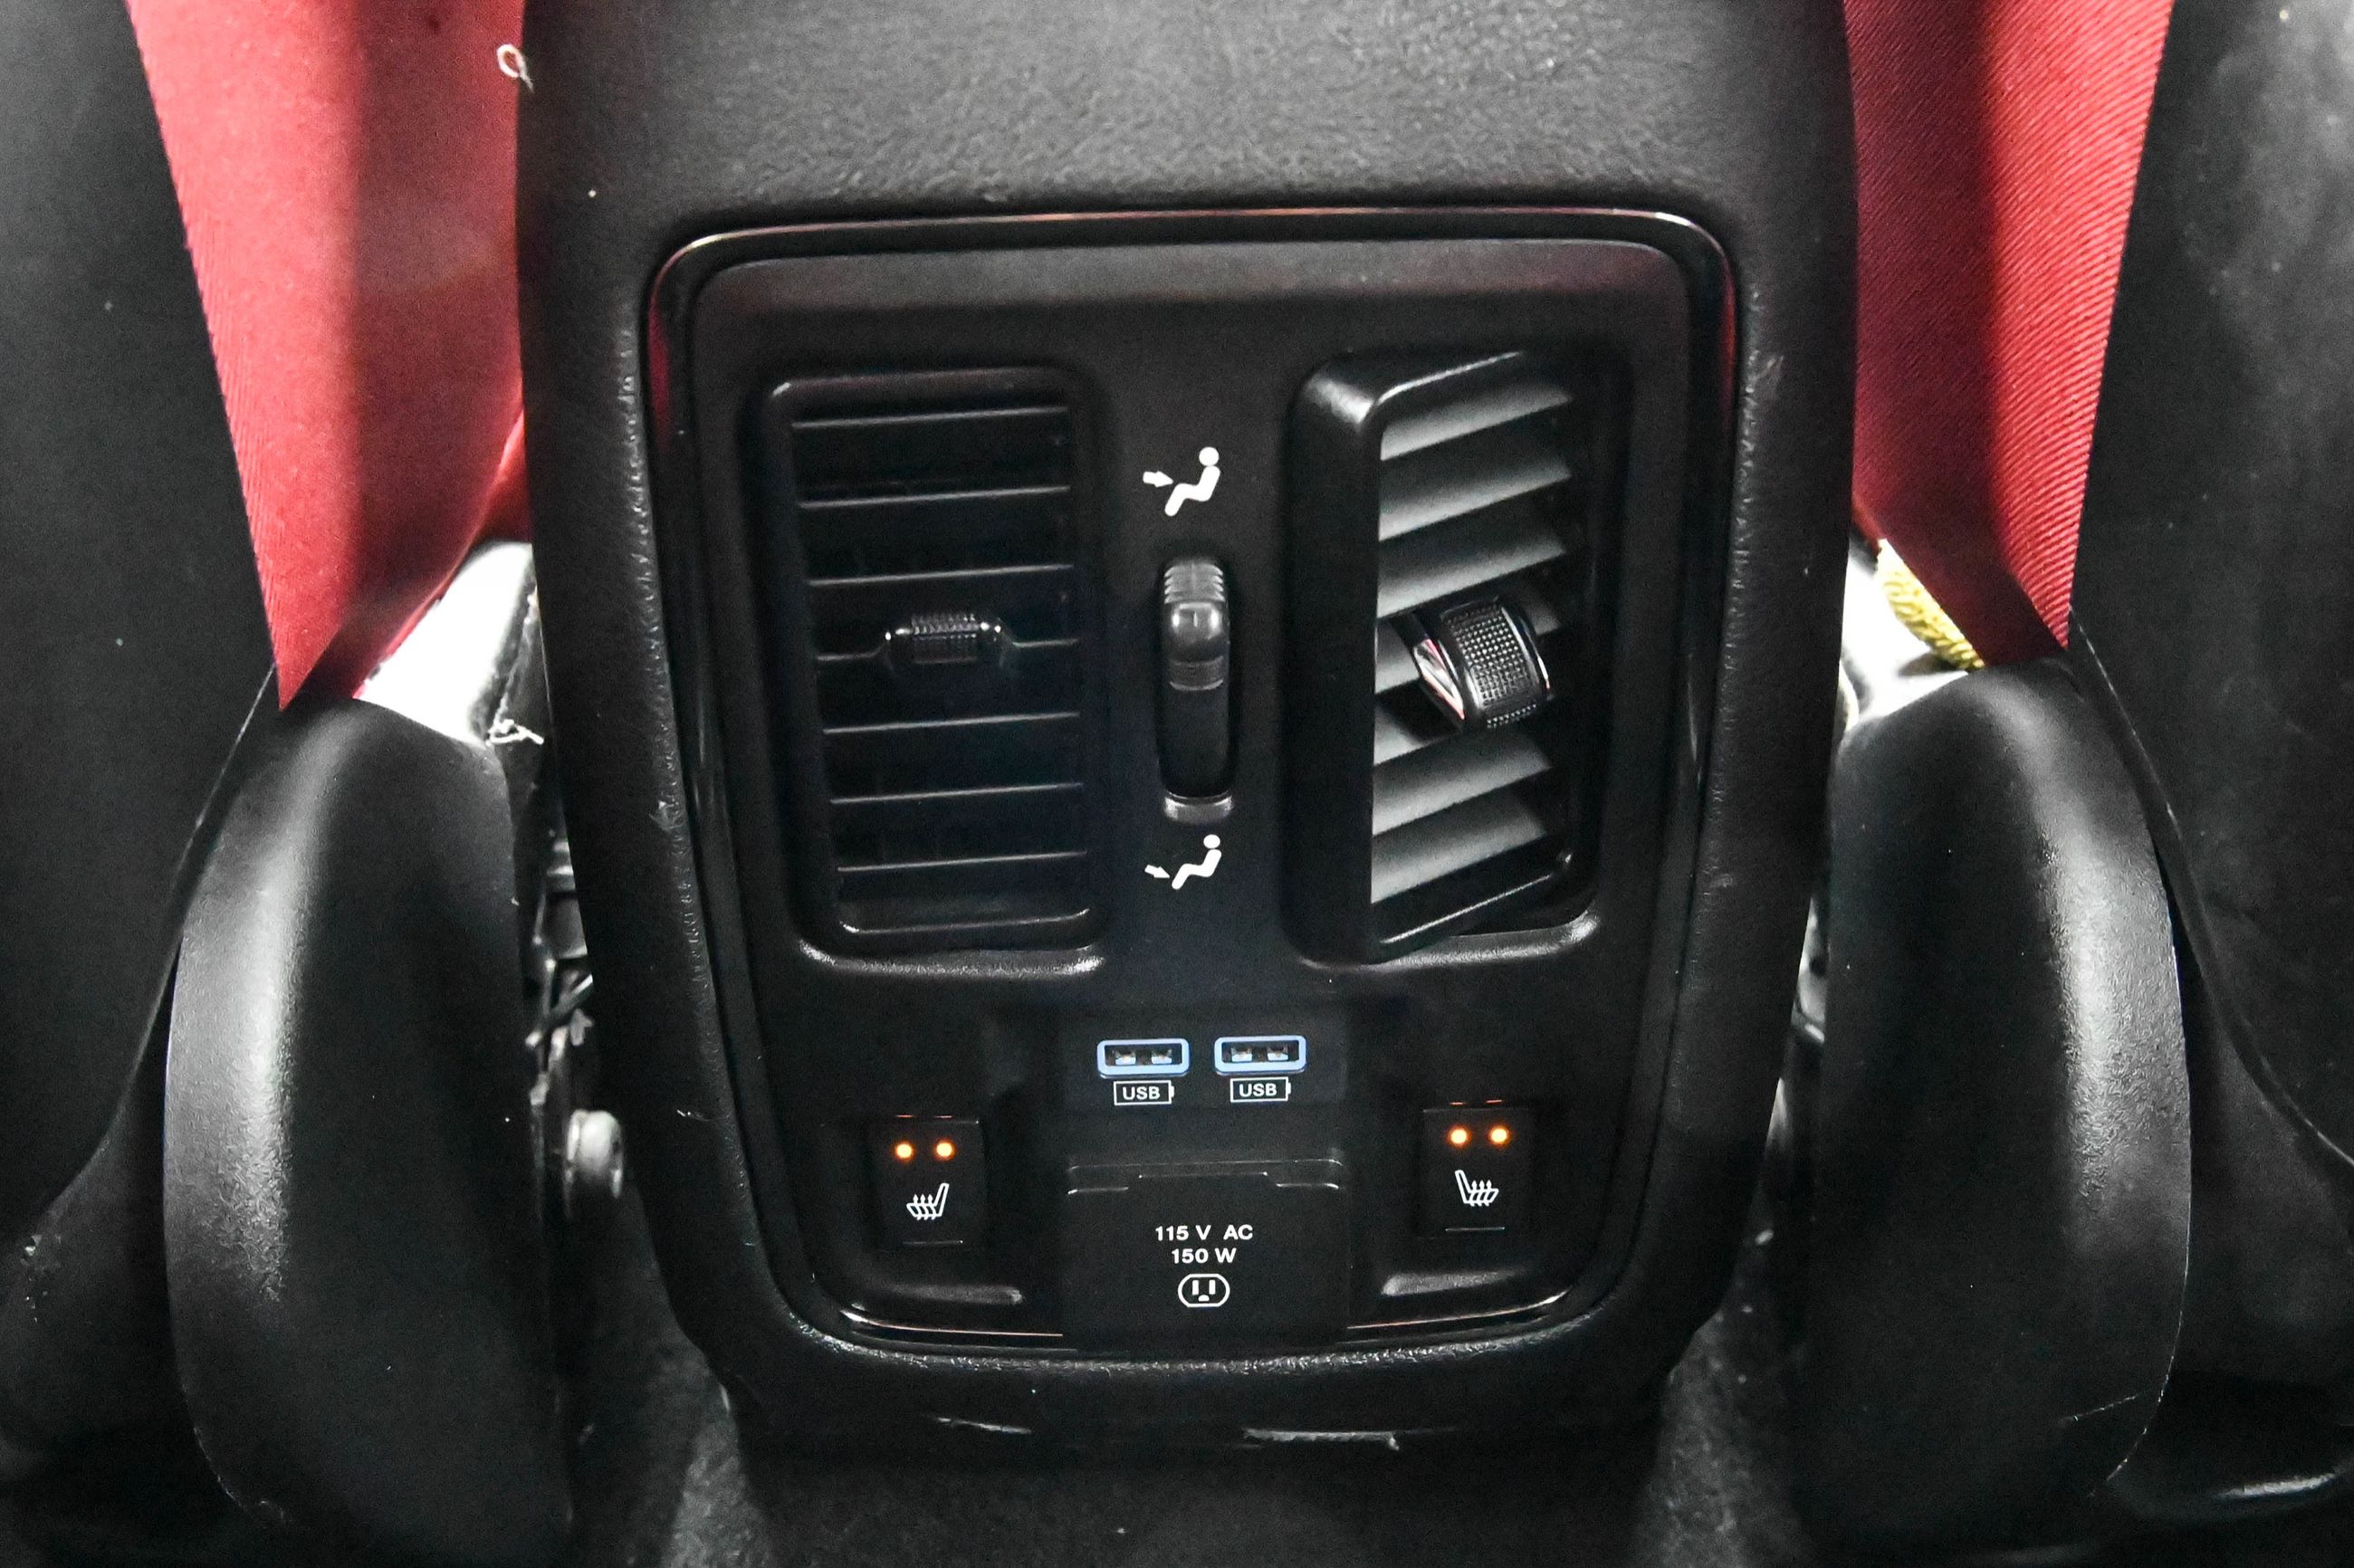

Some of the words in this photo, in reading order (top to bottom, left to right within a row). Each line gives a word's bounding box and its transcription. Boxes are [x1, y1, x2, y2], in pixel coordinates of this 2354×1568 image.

[1121, 1085, 1161, 1100] USB
[1238, 1082, 1277, 1097] USB
[1154, 1225, 1189, 1241] 115
[1195, 1224, 1211, 1241] V
[1222, 1224, 1254, 1240] AC
[1171, 1248, 1209, 1265] 150
[1214, 1248, 1238, 1264] W
